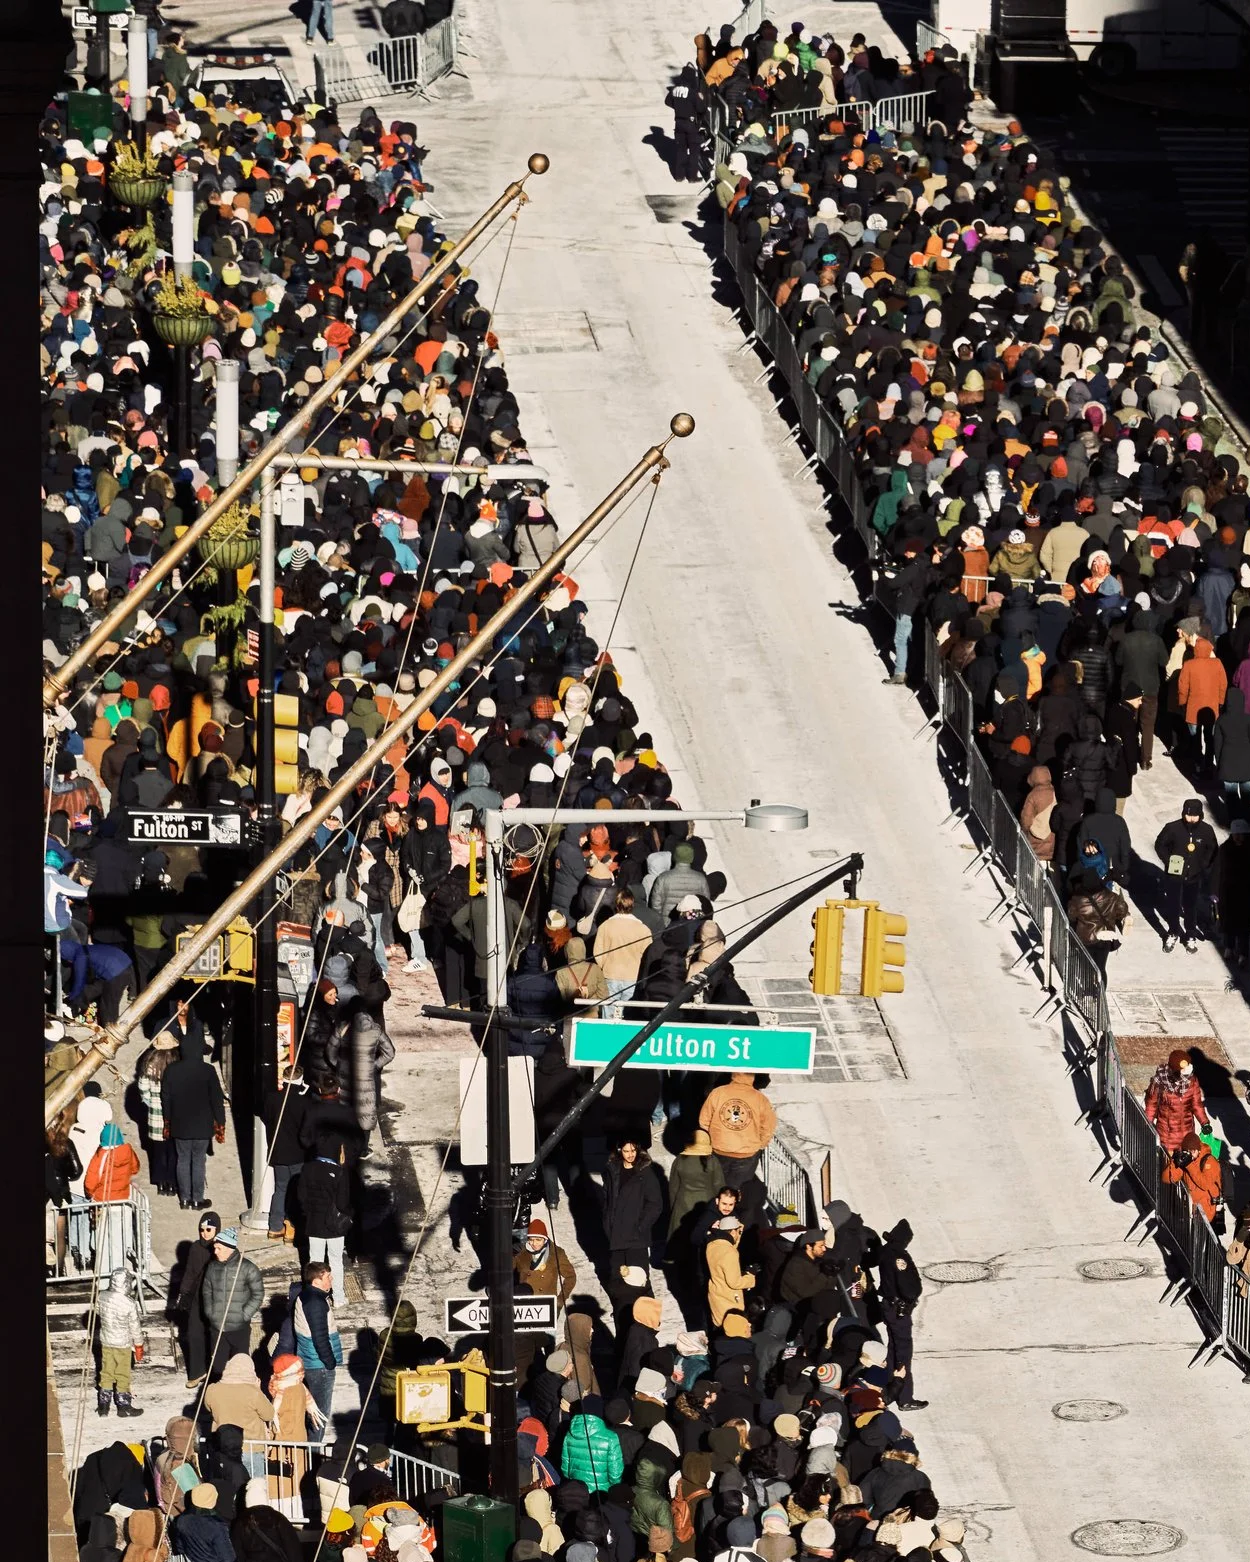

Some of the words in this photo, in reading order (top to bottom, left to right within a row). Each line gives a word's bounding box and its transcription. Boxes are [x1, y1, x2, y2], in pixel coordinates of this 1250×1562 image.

[133, 818, 189, 838] Fulton
[191, 821, 203, 831] ST
[727, 1036, 752, 1060] St
